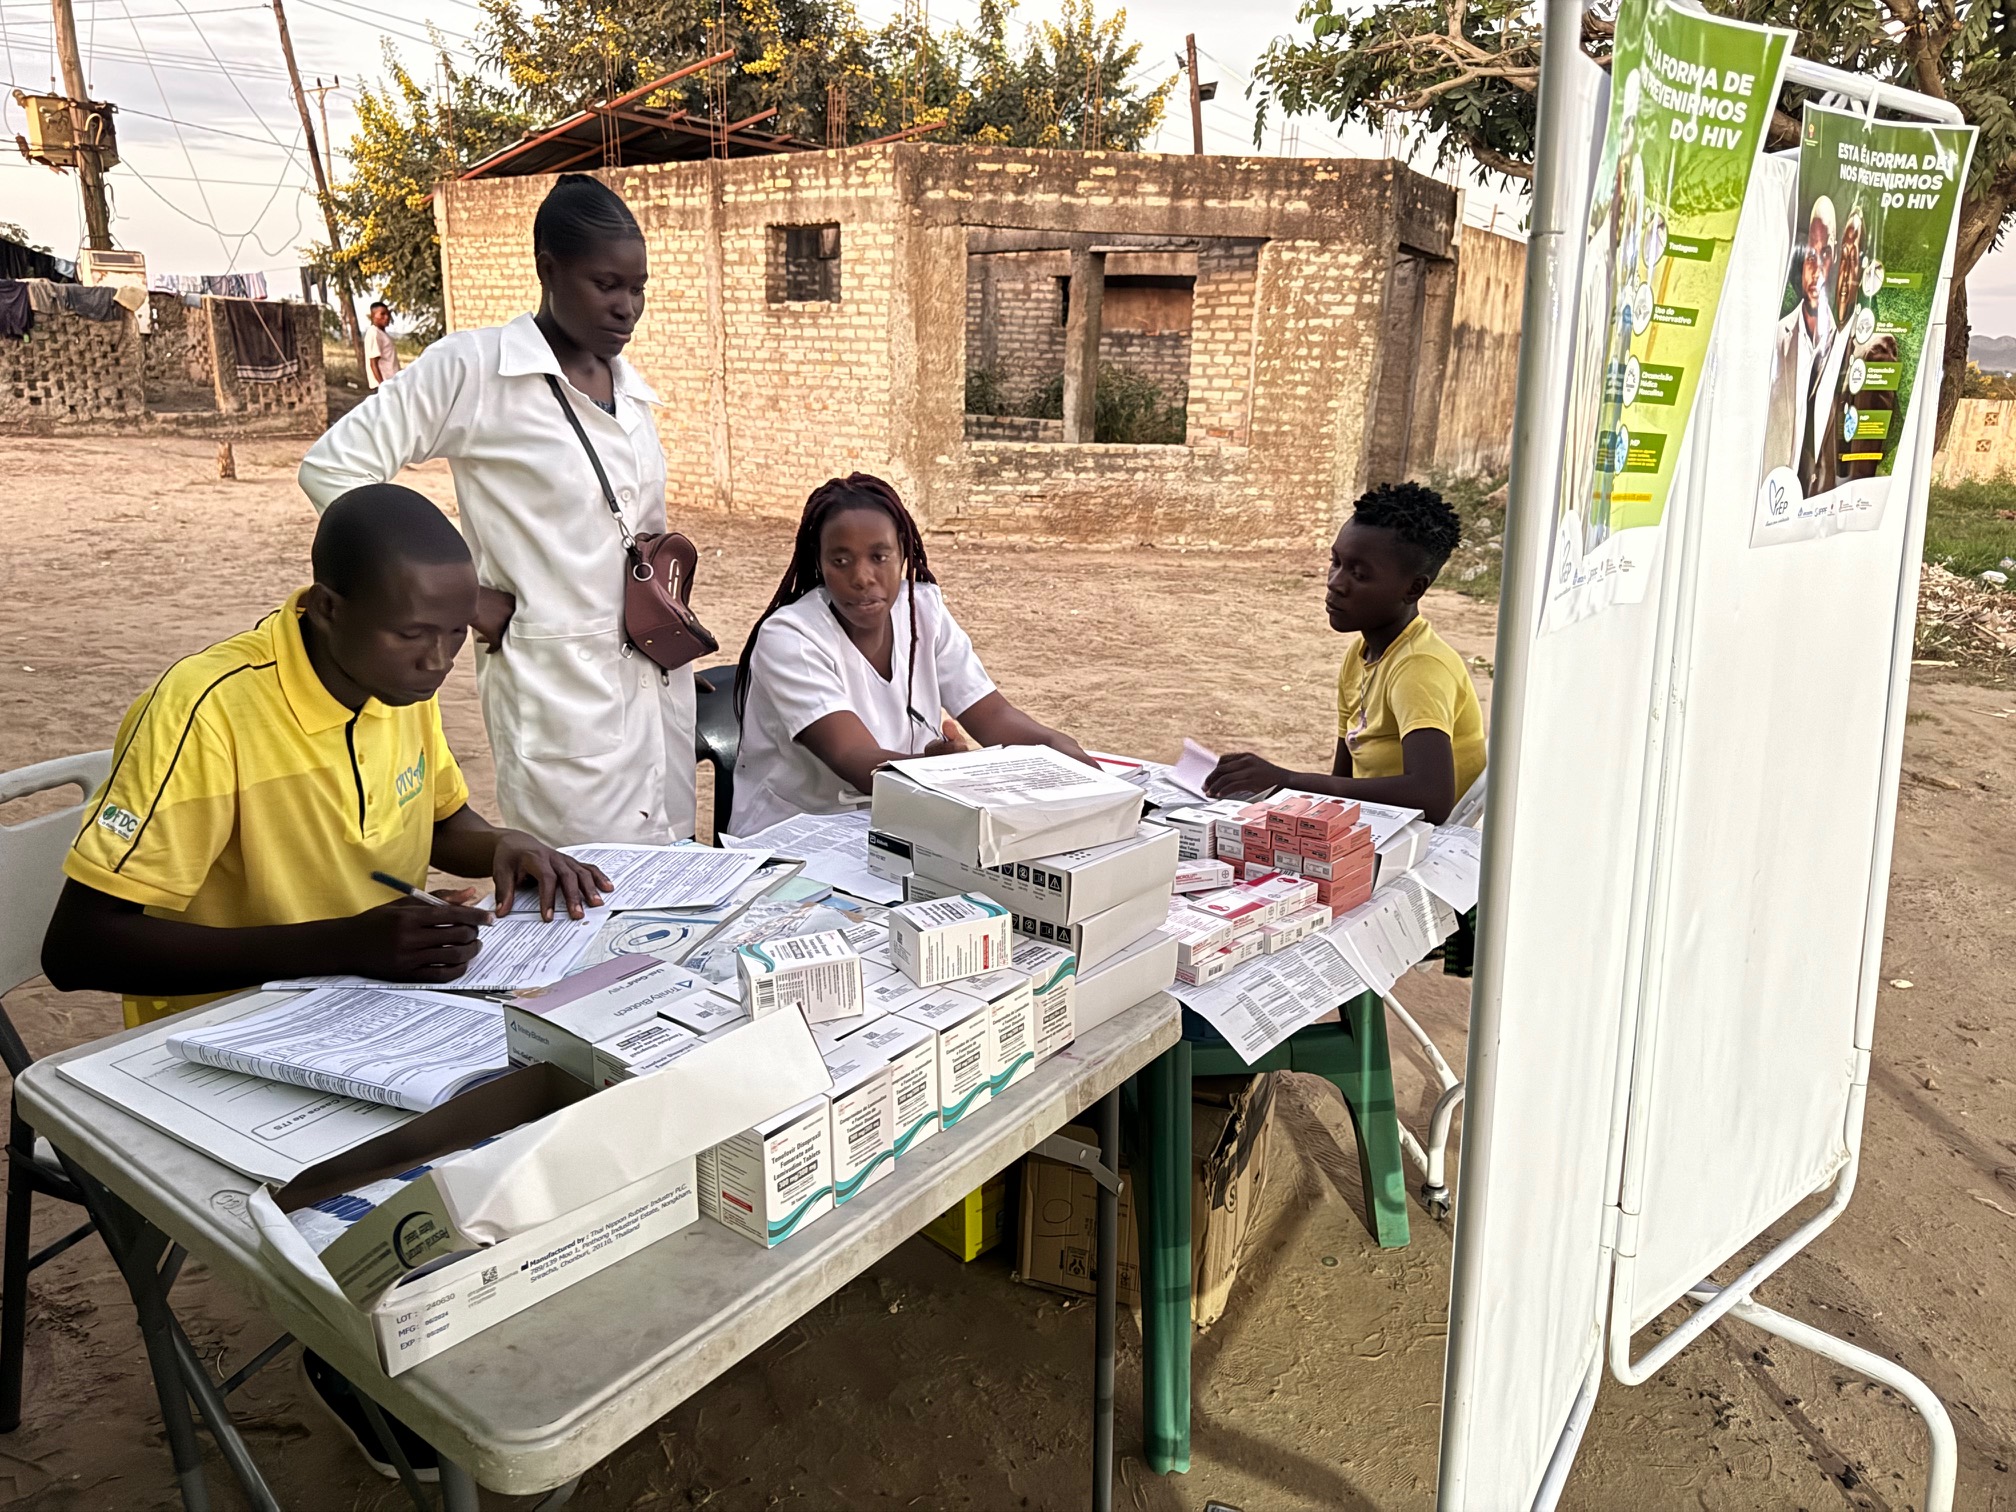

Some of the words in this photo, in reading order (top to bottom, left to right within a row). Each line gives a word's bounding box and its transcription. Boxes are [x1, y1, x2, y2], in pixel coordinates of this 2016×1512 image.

[1661, 53, 1718, 91] FORMA
[1723, 70, 1755, 96] DE
[1670, 118, 1698, 143] DO
[1701, 124, 1743, 150] HIV
[1838, 142, 1860, 162] ESTA
[1870, 151, 1918, 171] FORMA
[1840, 163, 1858, 182] NOS
[1881, 192, 1905, 209] DO
[1907, 193, 1940, 209] HIV
[1669, 242, 1699, 254] Testagem
[1653, 311, 1692, 325] Preservativo
[651, 986, 683, 1001] Trinity
[613, 998, 654, 1017] Biotech
[307, 1099, 340, 1115] Casos
[273, 1120, 293, 1131] ITS
[292, 1113, 306, 1122] de
[772, 1145, 795, 1164] Tenofovir
[797, 1130, 821, 1150] Disoproxil
[780, 1149, 803, 1168] Fumarate
[804, 1143, 813, 1154] and
[773, 1159, 801, 1181] Lamivudine
[803, 1148, 820, 1163] Tablets
[809, 1162, 816, 1172] mg
[529, 1241, 576, 1267] Manufactured
[577, 1236, 585, 1245] by
[590, 1226, 604, 1240] Thai
[605, 1215, 627, 1231] Nippon
[628, 1203, 650, 1219] Rubber
[650, 1192, 674, 1208] Industry
[674, 1183, 688, 1195] PLC.
[530, 1257, 558, 1276] 789/139
[558, 1250, 573, 1261] Moo
[574, 1246, 581, 1254] 1,
[582, 1231, 610, 1251] Pinthong
[610, 1216, 639, 1236] Industrial
[640, 1207, 660, 1221] Estate,
[661, 1189, 693, 1209] Nongkham,
[530, 1265, 559, 1284] Sriracha,
[560, 1250, 591, 1268] Chonburi,
[592, 1238, 613, 1252] 20110,
[614, 1223, 641, 1240] Thailand
[396, 1312, 412, 1325] LOT
[425, 1292, 456, 1312] 240630
[400, 1338, 416, 1351] EXP
